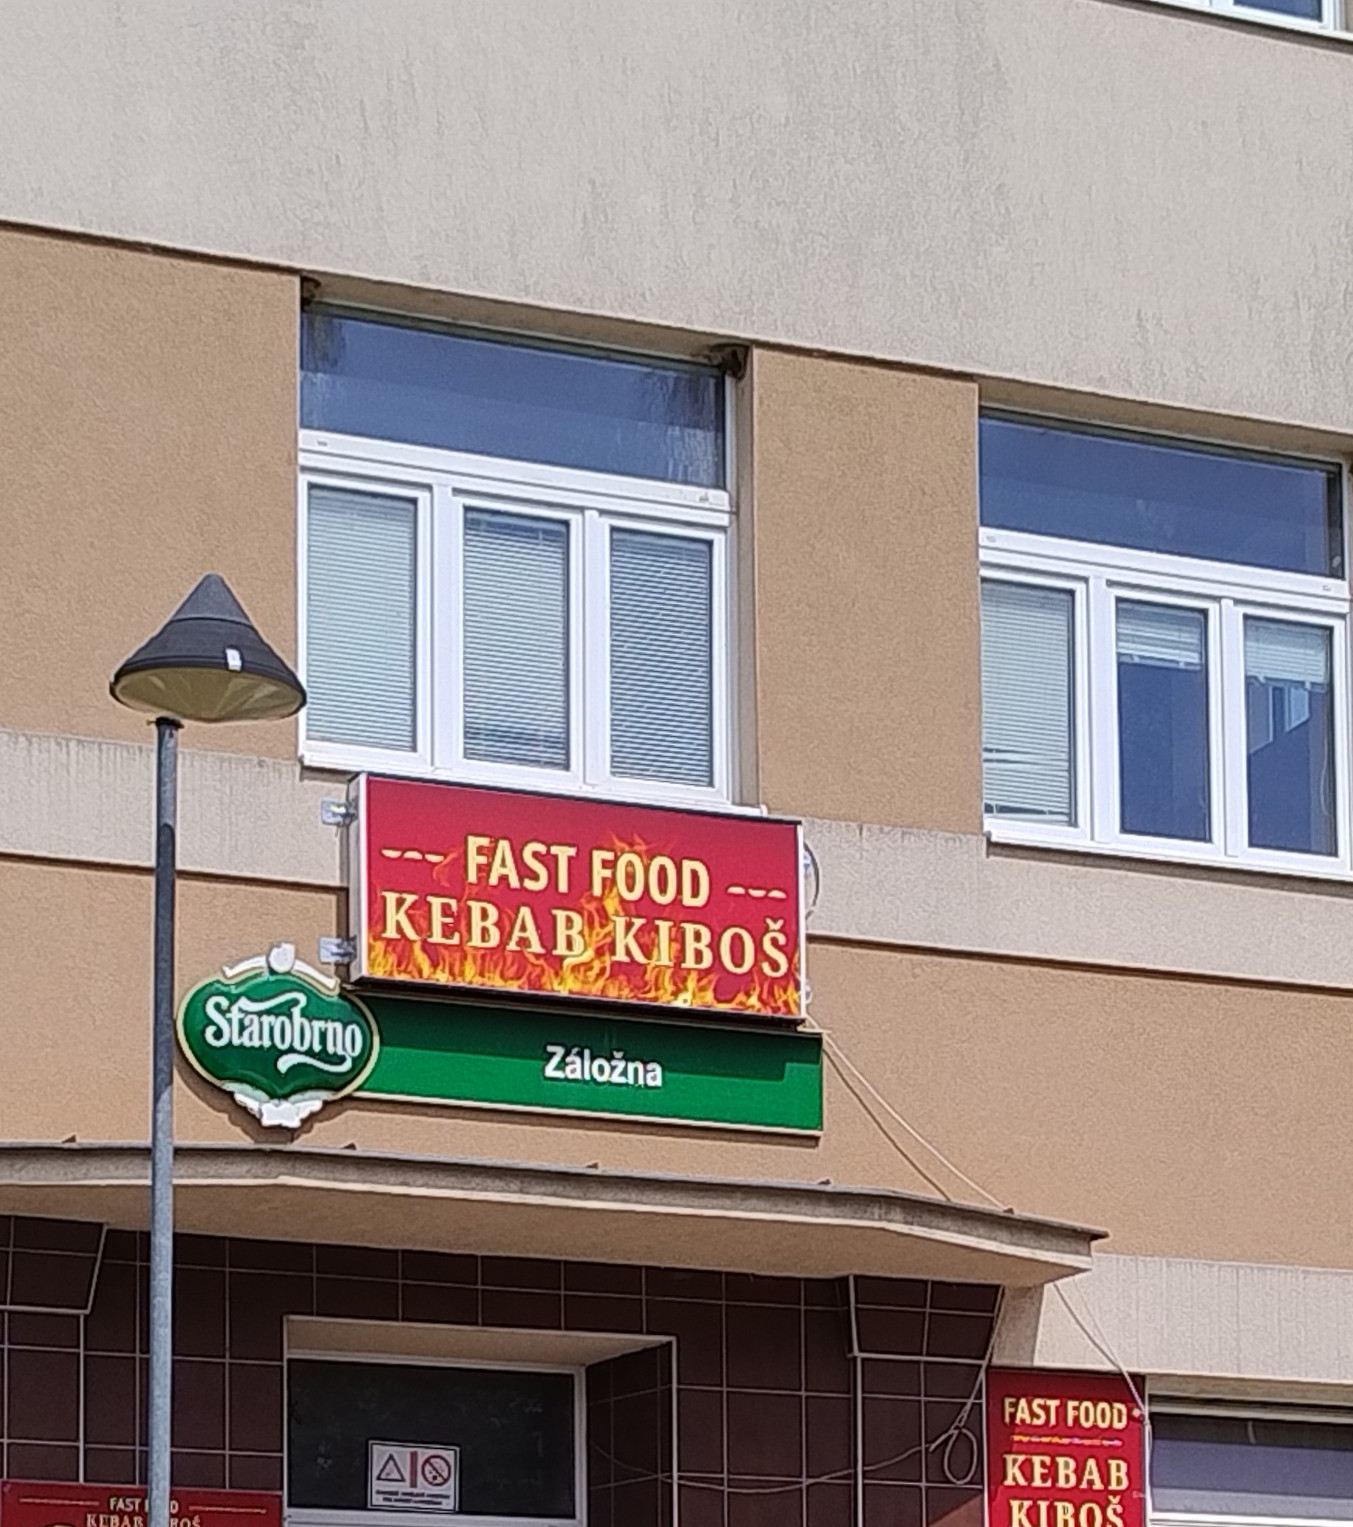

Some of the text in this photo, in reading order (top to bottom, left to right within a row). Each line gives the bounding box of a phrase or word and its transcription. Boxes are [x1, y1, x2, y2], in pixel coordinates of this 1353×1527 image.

[467, 835, 709, 907] FAST FOOD
[382, 892, 789, 977] KEBAB KIBOŠ
[204, 992, 363, 1074] Starobrno
[545, 1045, 663, 1087] Záložna
[1003, 1398, 1128, 1430] FAST FOOD
[1003, 1453, 1130, 1491] KEBAB
[109, 1497, 142, 1512] FAST
